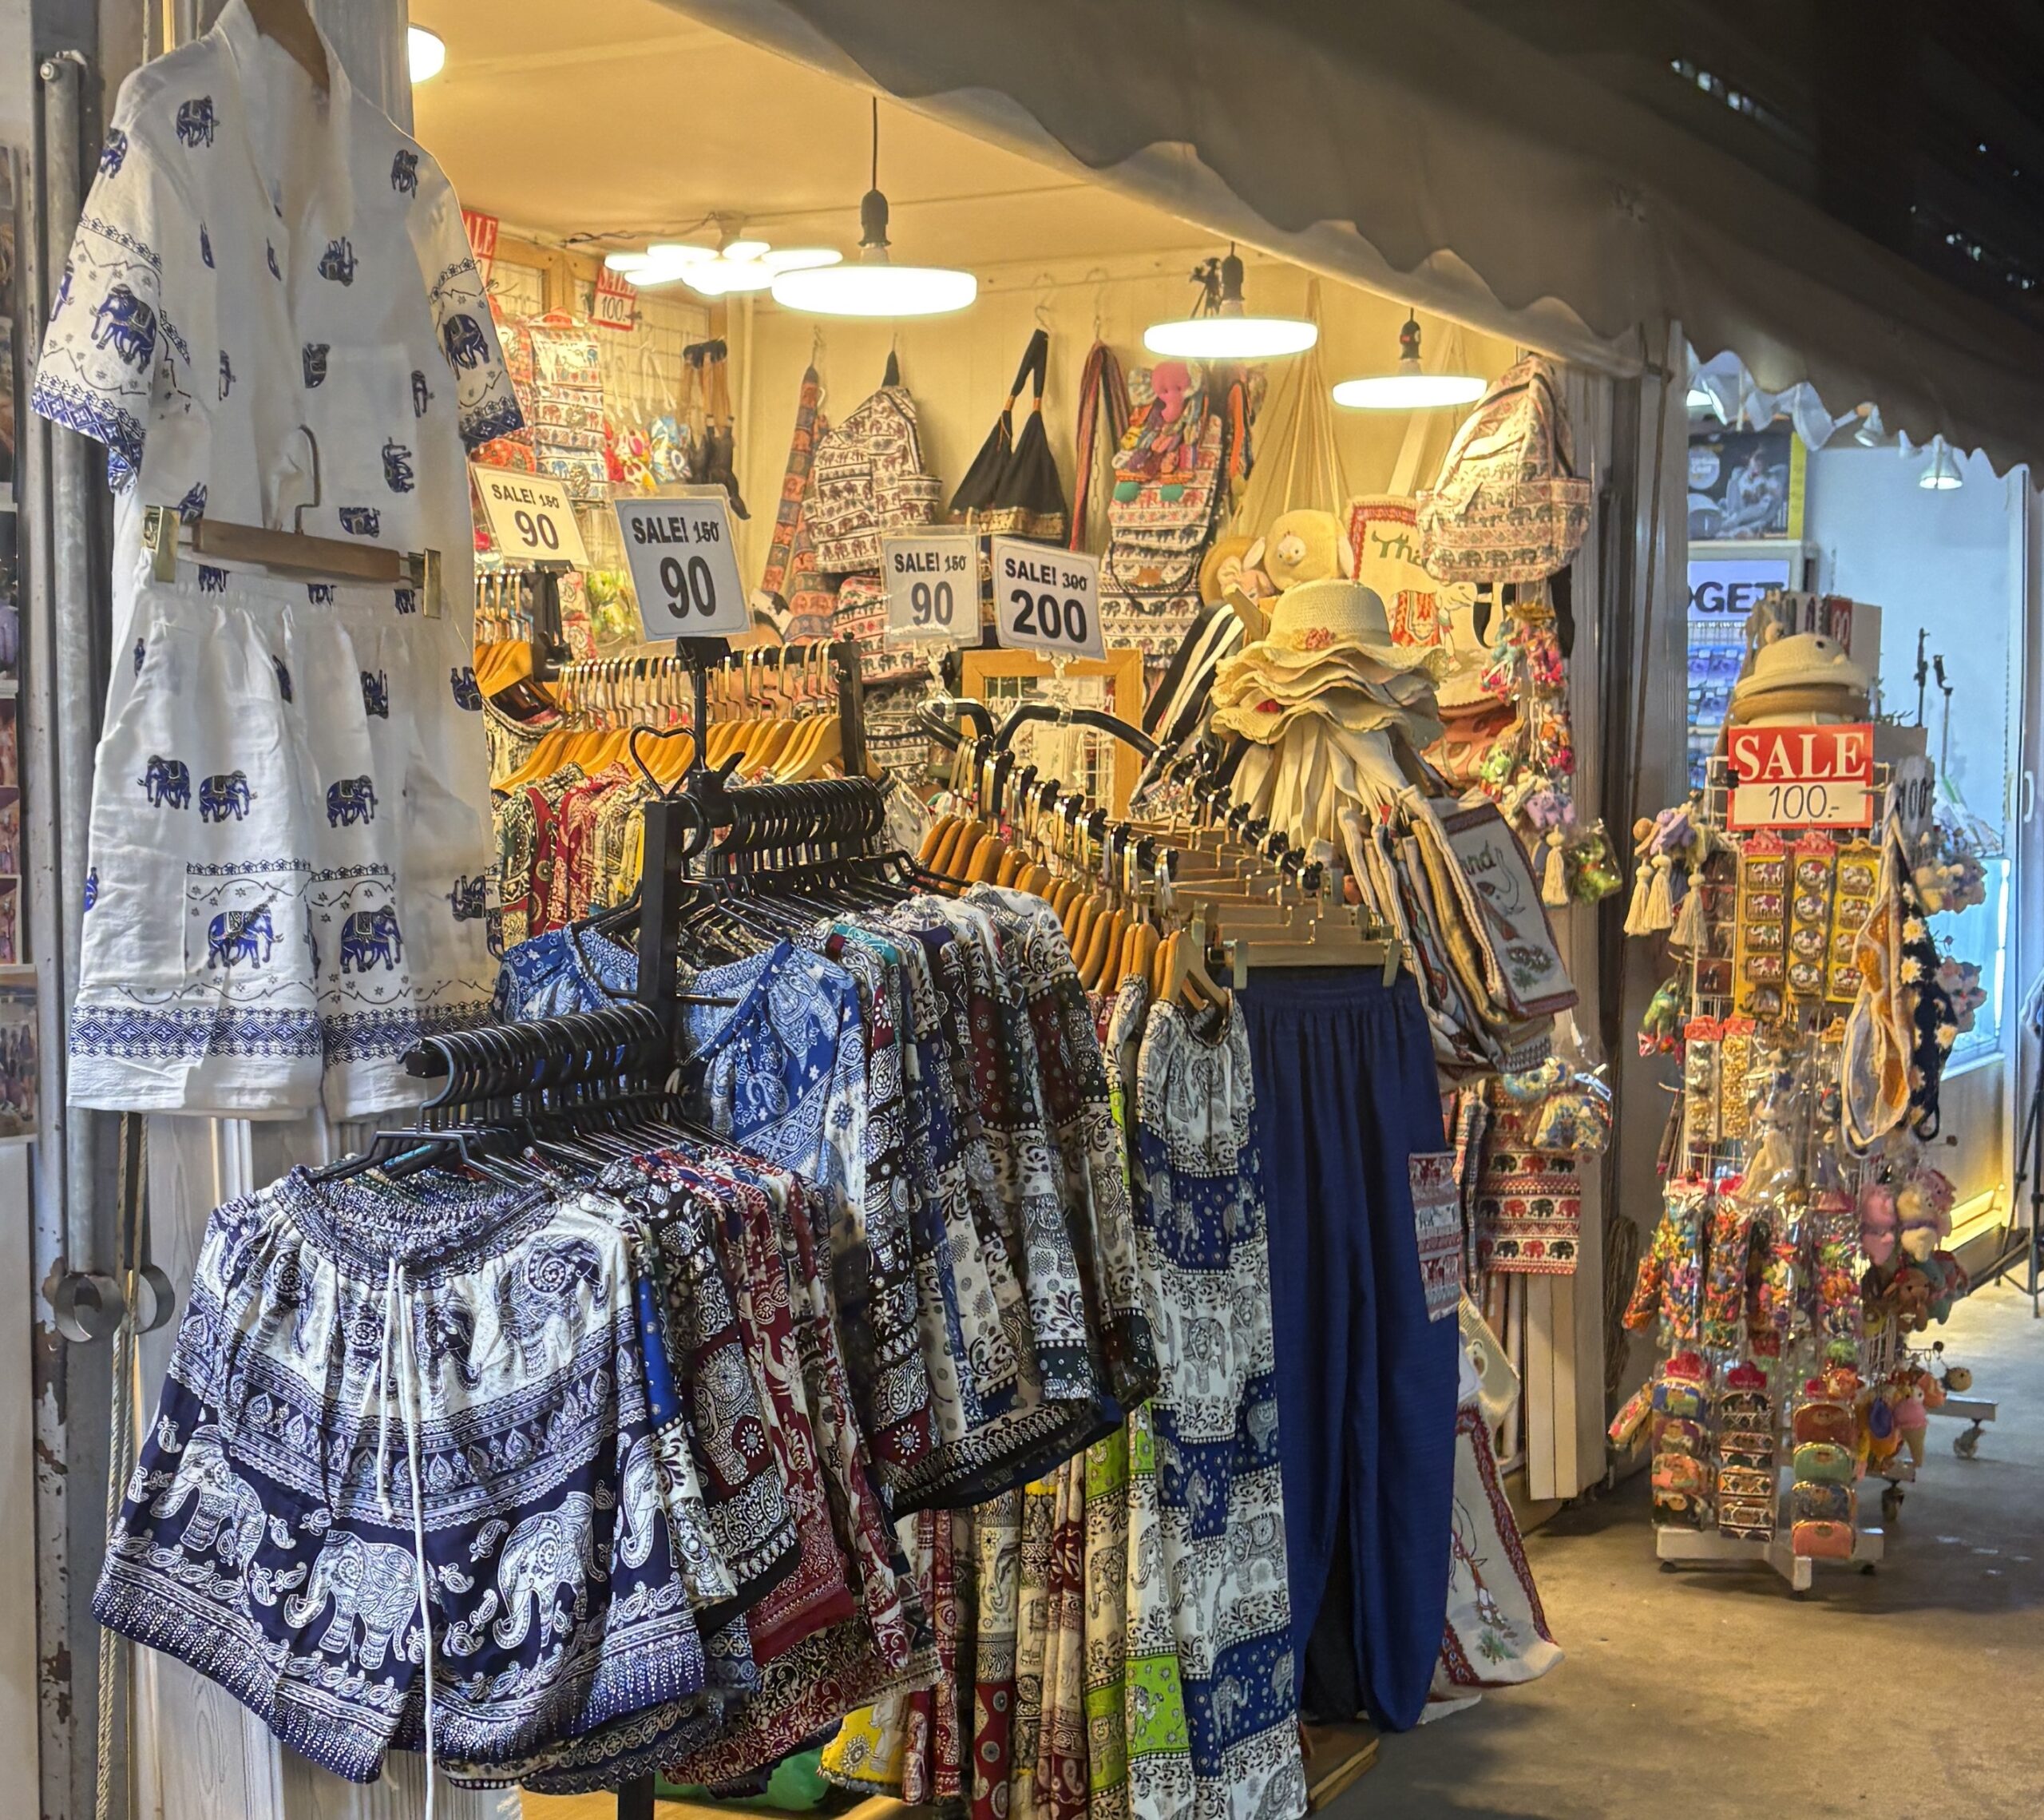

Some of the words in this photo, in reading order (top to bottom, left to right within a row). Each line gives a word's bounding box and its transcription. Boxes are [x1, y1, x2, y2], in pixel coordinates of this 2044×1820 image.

[491, 484, 537, 506] SALE!
[515, 510, 559, 550] 90
[632, 517, 689, 545] SALE!
[894, 552, 940, 573] SALE!
[1004, 558, 1057, 586] SALE!
[1062, 572, 1089, 592] 300
[660, 556, 716, 619] 90
[911, 581, 954, 626] 90
[1687, 581, 1785, 613] GET
[1010, 589, 1087, 644] 200
[1734, 732, 1867, 782] SALE
[1769, 784, 1840, 819] 100.-
